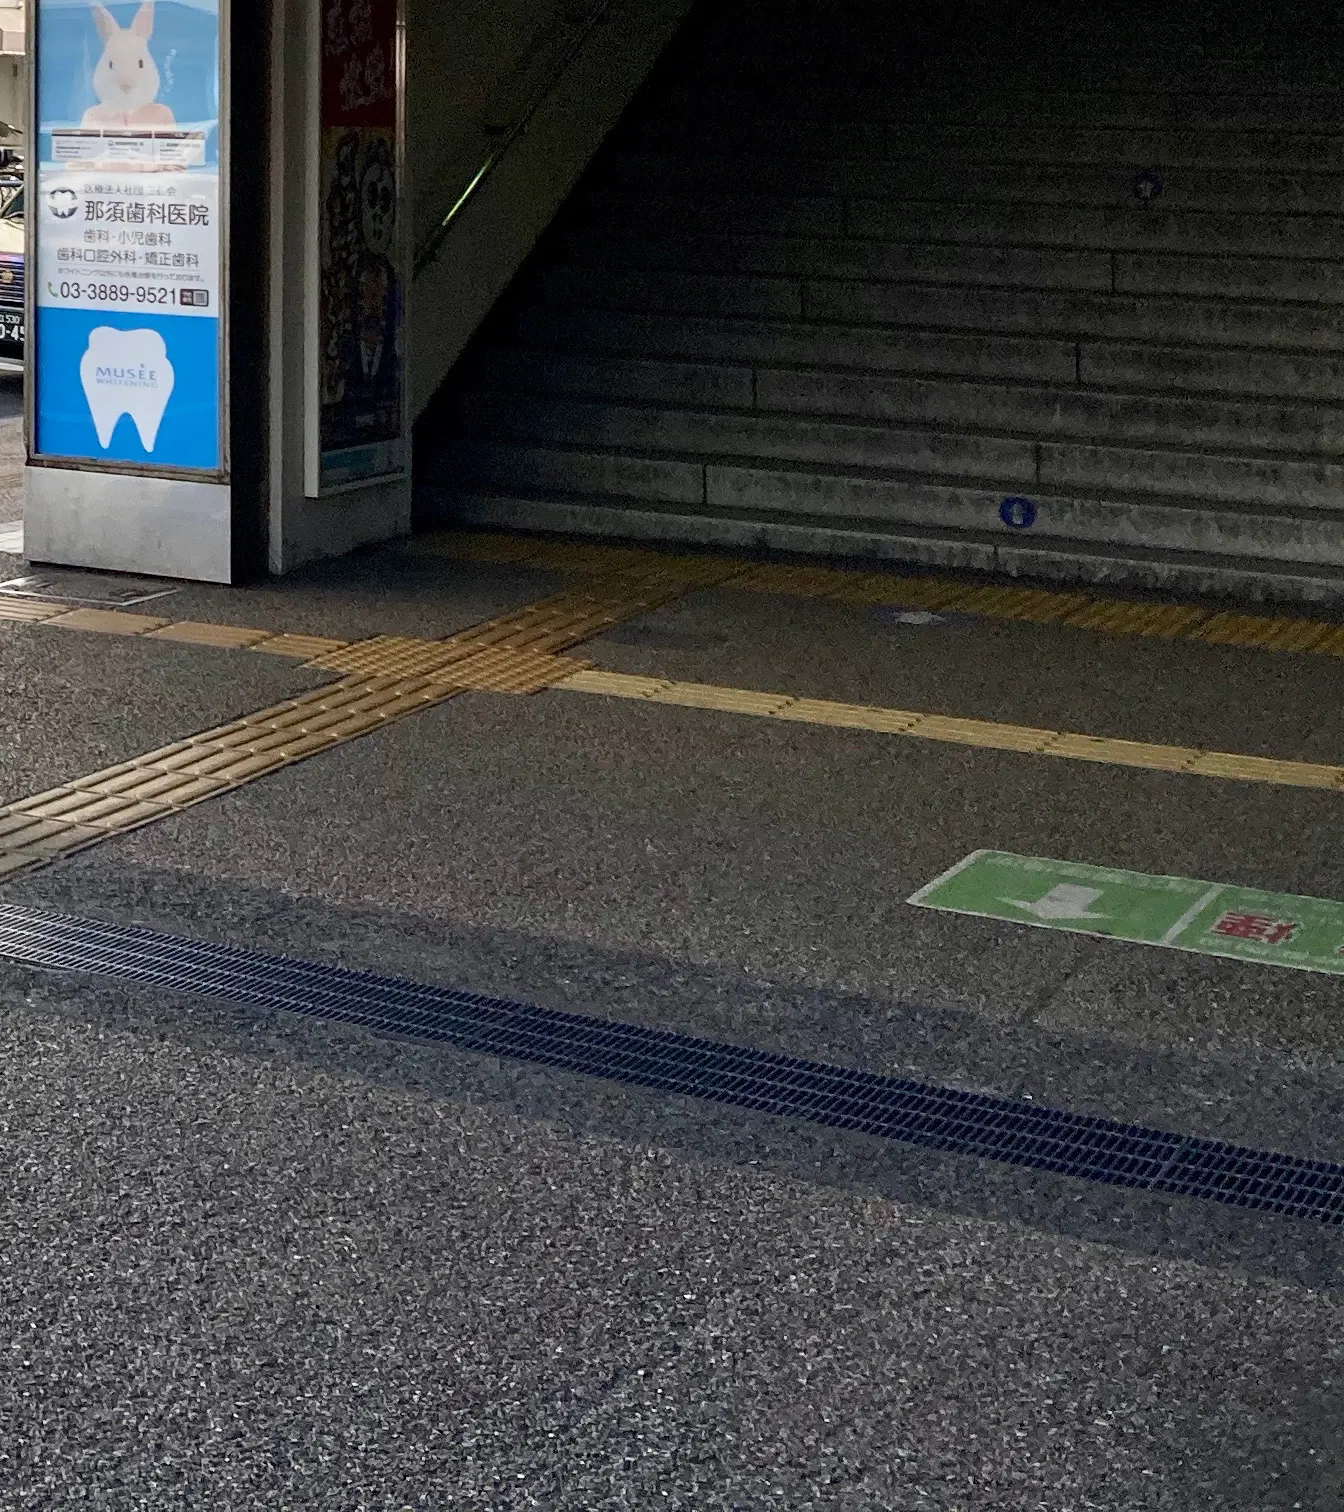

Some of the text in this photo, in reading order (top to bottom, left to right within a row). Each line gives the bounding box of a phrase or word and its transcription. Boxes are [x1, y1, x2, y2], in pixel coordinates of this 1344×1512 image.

[84, 200, 210, 227] 那須歯科医院
[60, 281, 177, 305] 03-3889-9521
